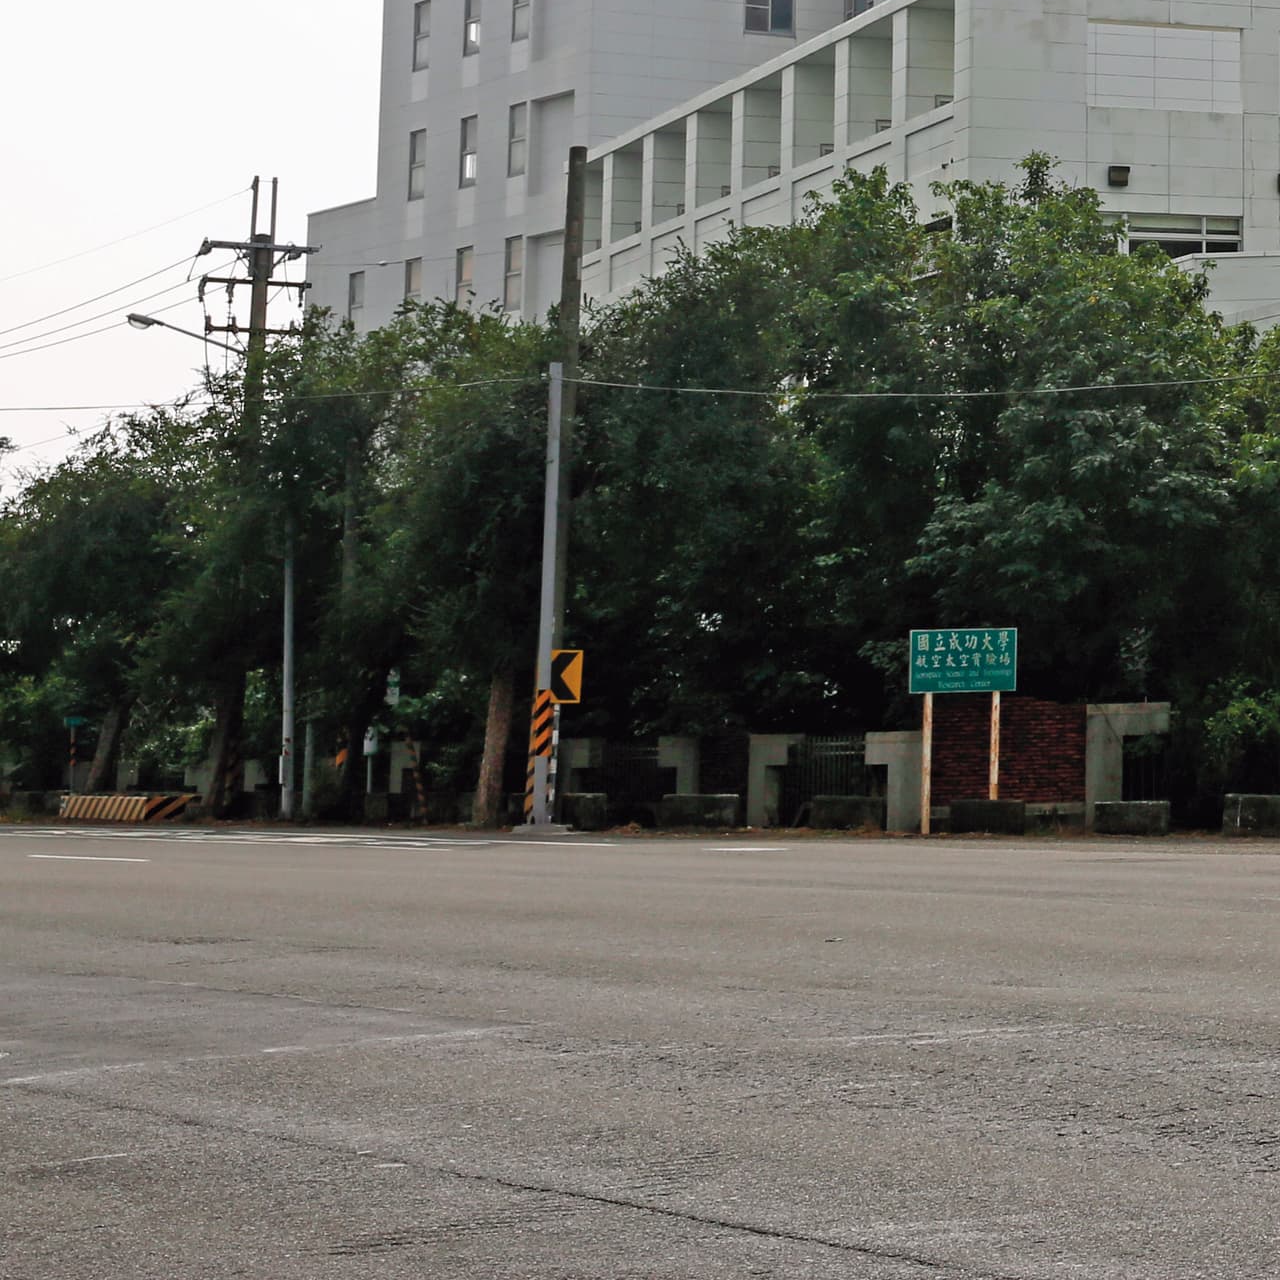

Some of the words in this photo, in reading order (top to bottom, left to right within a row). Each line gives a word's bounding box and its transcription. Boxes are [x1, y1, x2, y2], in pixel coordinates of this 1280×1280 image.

[917, 631, 1009, 651] 國立成功大學
[915, 652, 1011, 668] 航空太空實驗場
